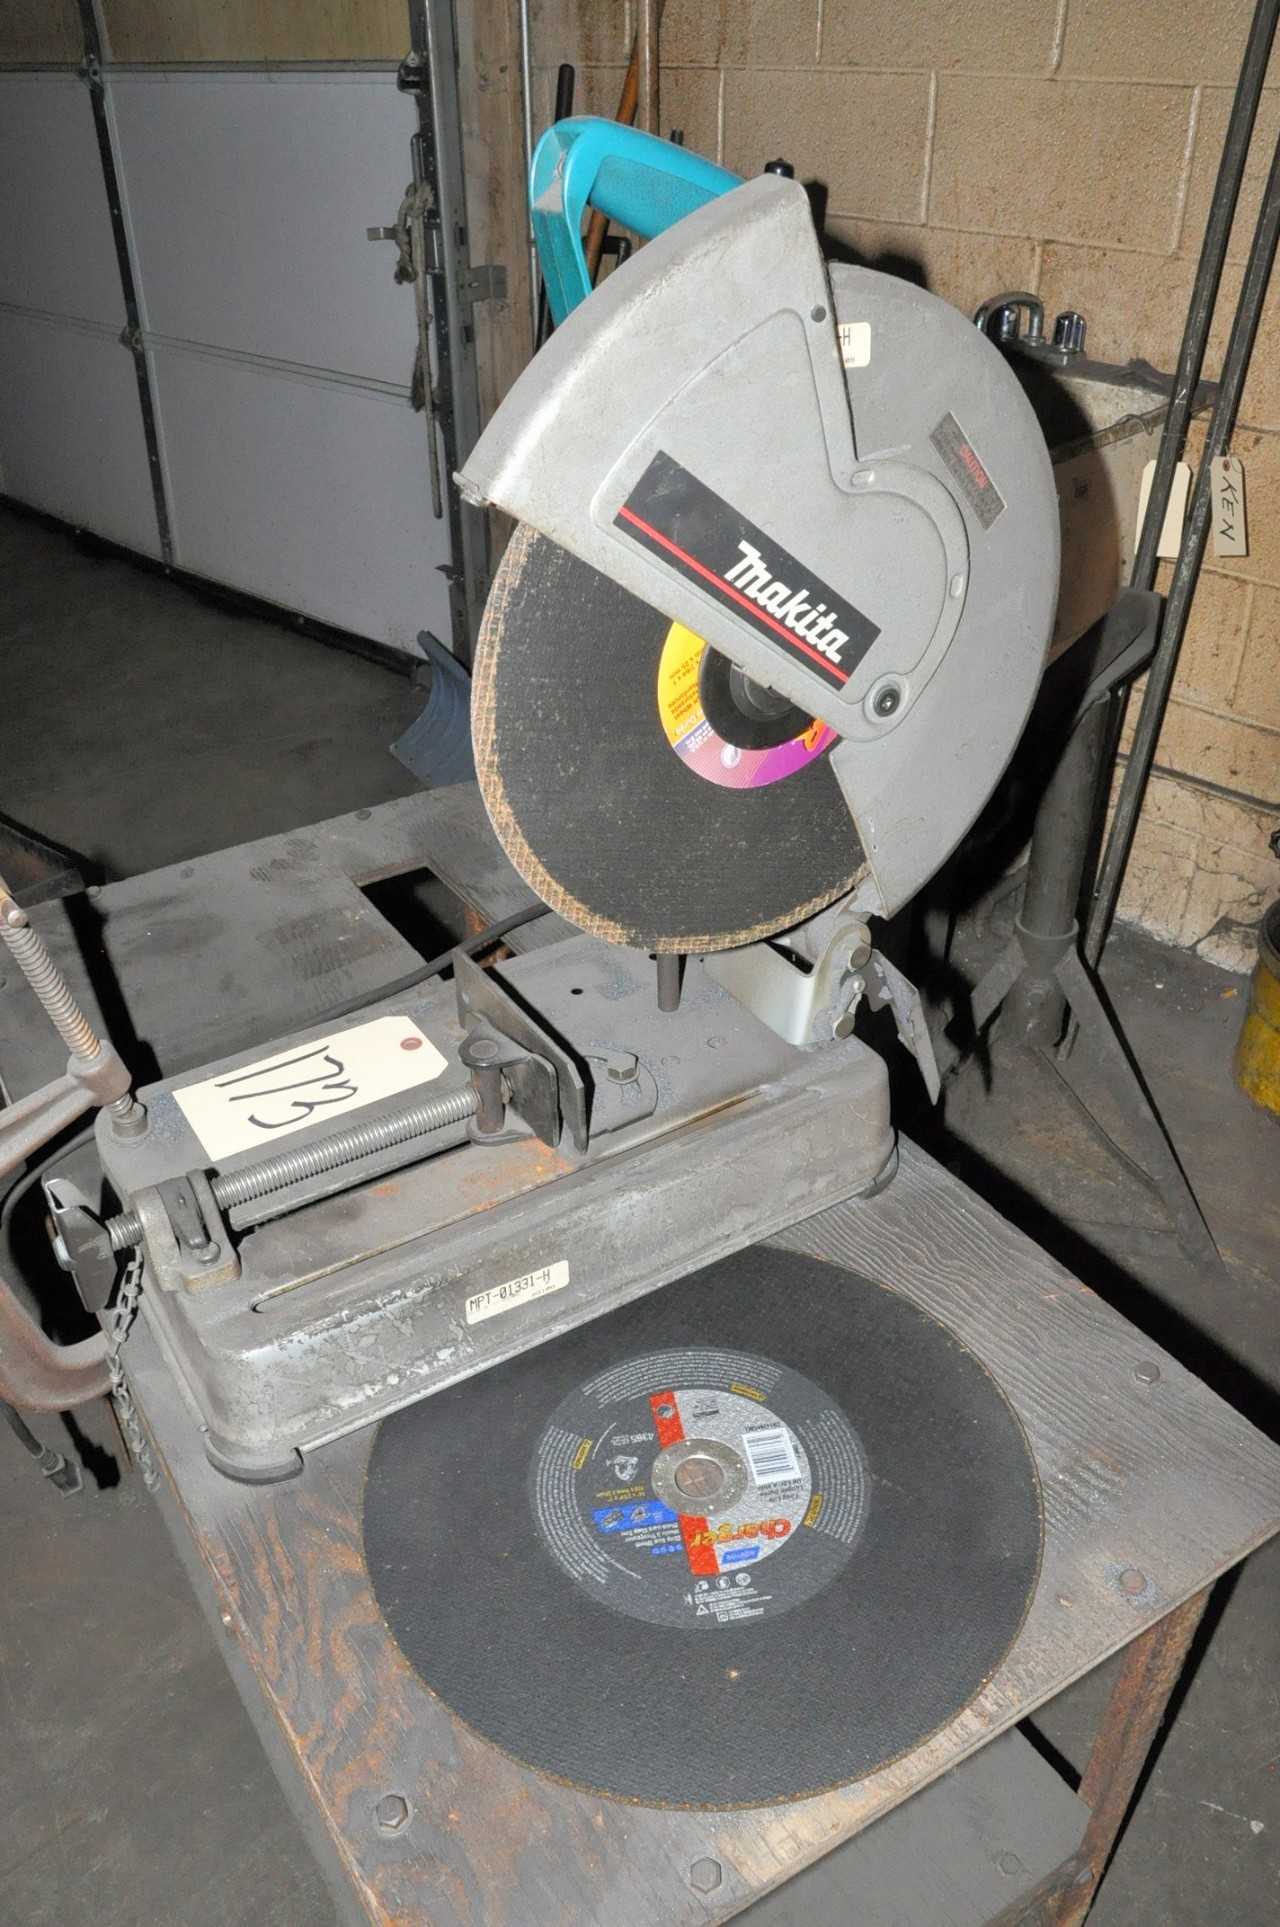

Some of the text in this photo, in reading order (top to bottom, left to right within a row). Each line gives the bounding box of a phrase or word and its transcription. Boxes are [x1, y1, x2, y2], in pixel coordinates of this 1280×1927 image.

[1218, 475, 1239, 542] KEN
[723, 540, 850, 664] Makita
[469, 1268, 551, 1313] MPT-01331-H
[690, 1518, 792, 1549] Charger
